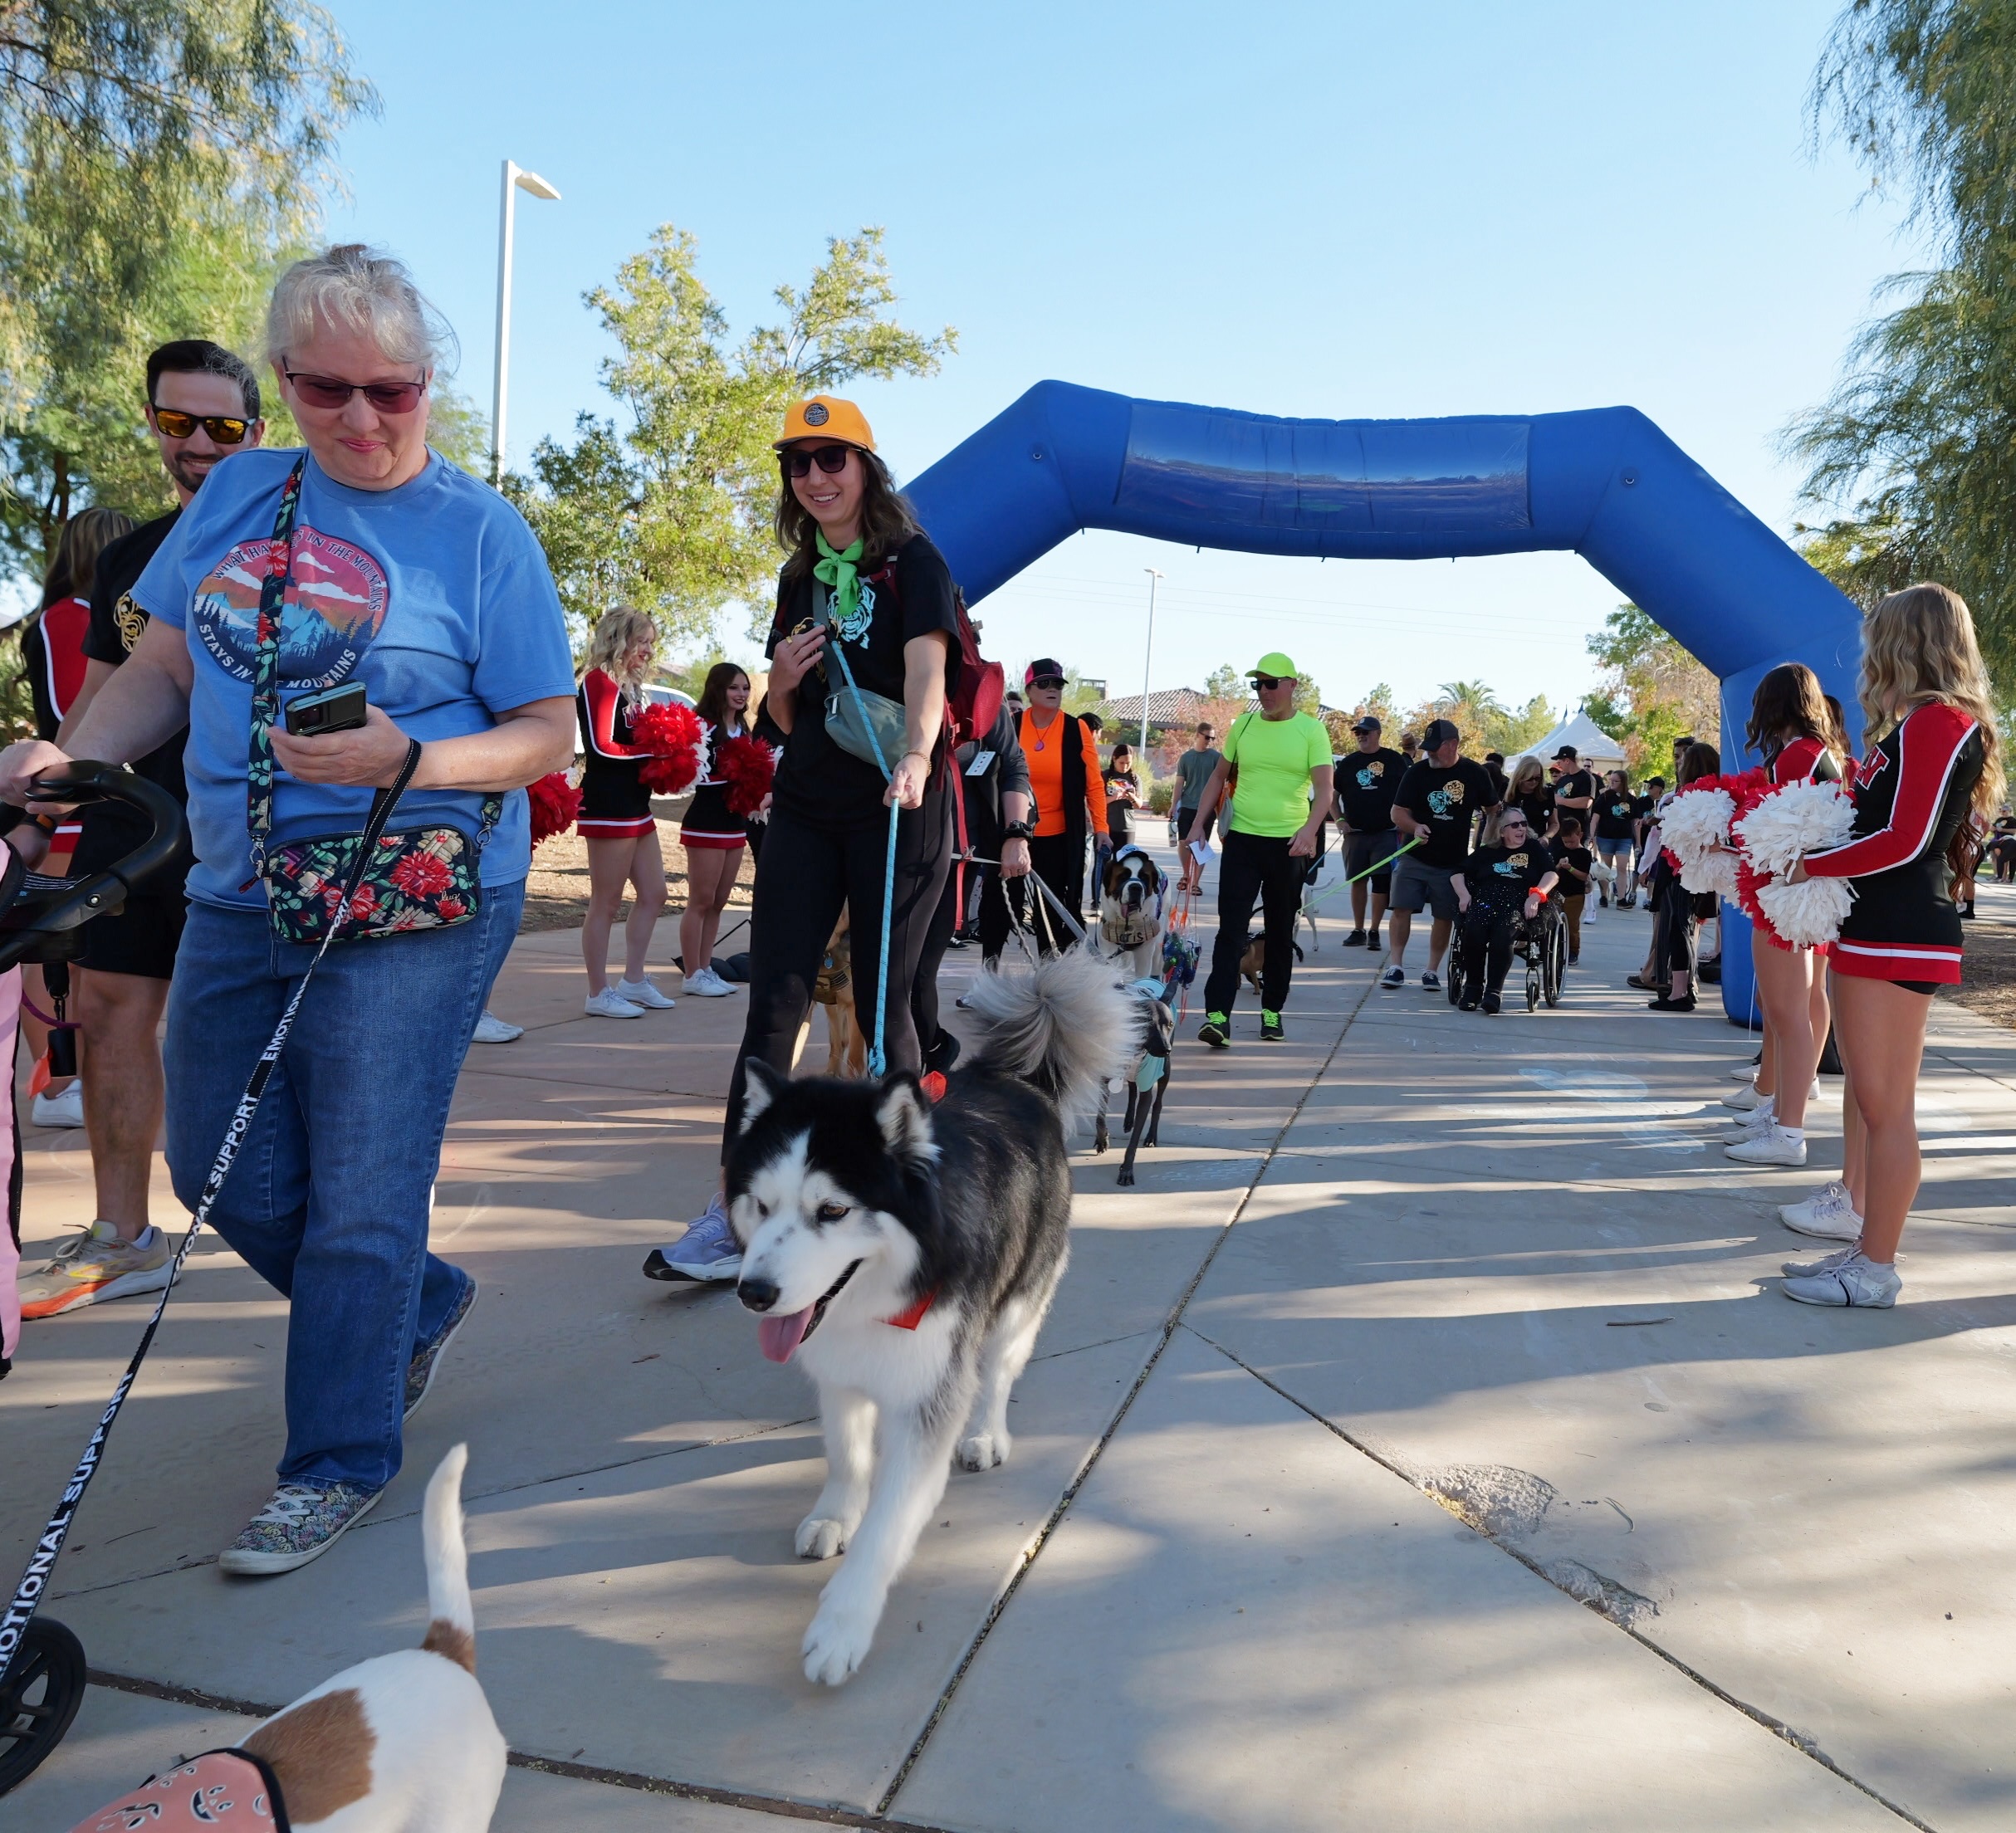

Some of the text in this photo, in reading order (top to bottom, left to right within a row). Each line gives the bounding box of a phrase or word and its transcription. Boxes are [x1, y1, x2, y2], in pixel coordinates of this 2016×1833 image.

[213, 550, 247, 579] WHAT
[306, 531, 325, 548] IN
[325, 542, 354, 561] THE
[350, 554, 384, 612] MOUNTAINS
[199, 623, 356, 688] STAYS IN MOUNTAINS
[0, 1509, 72, 1672] OTIONAL
[62, 1372, 134, 1503] SUPPORT
[210, 1092, 260, 1188] SUPPORT
